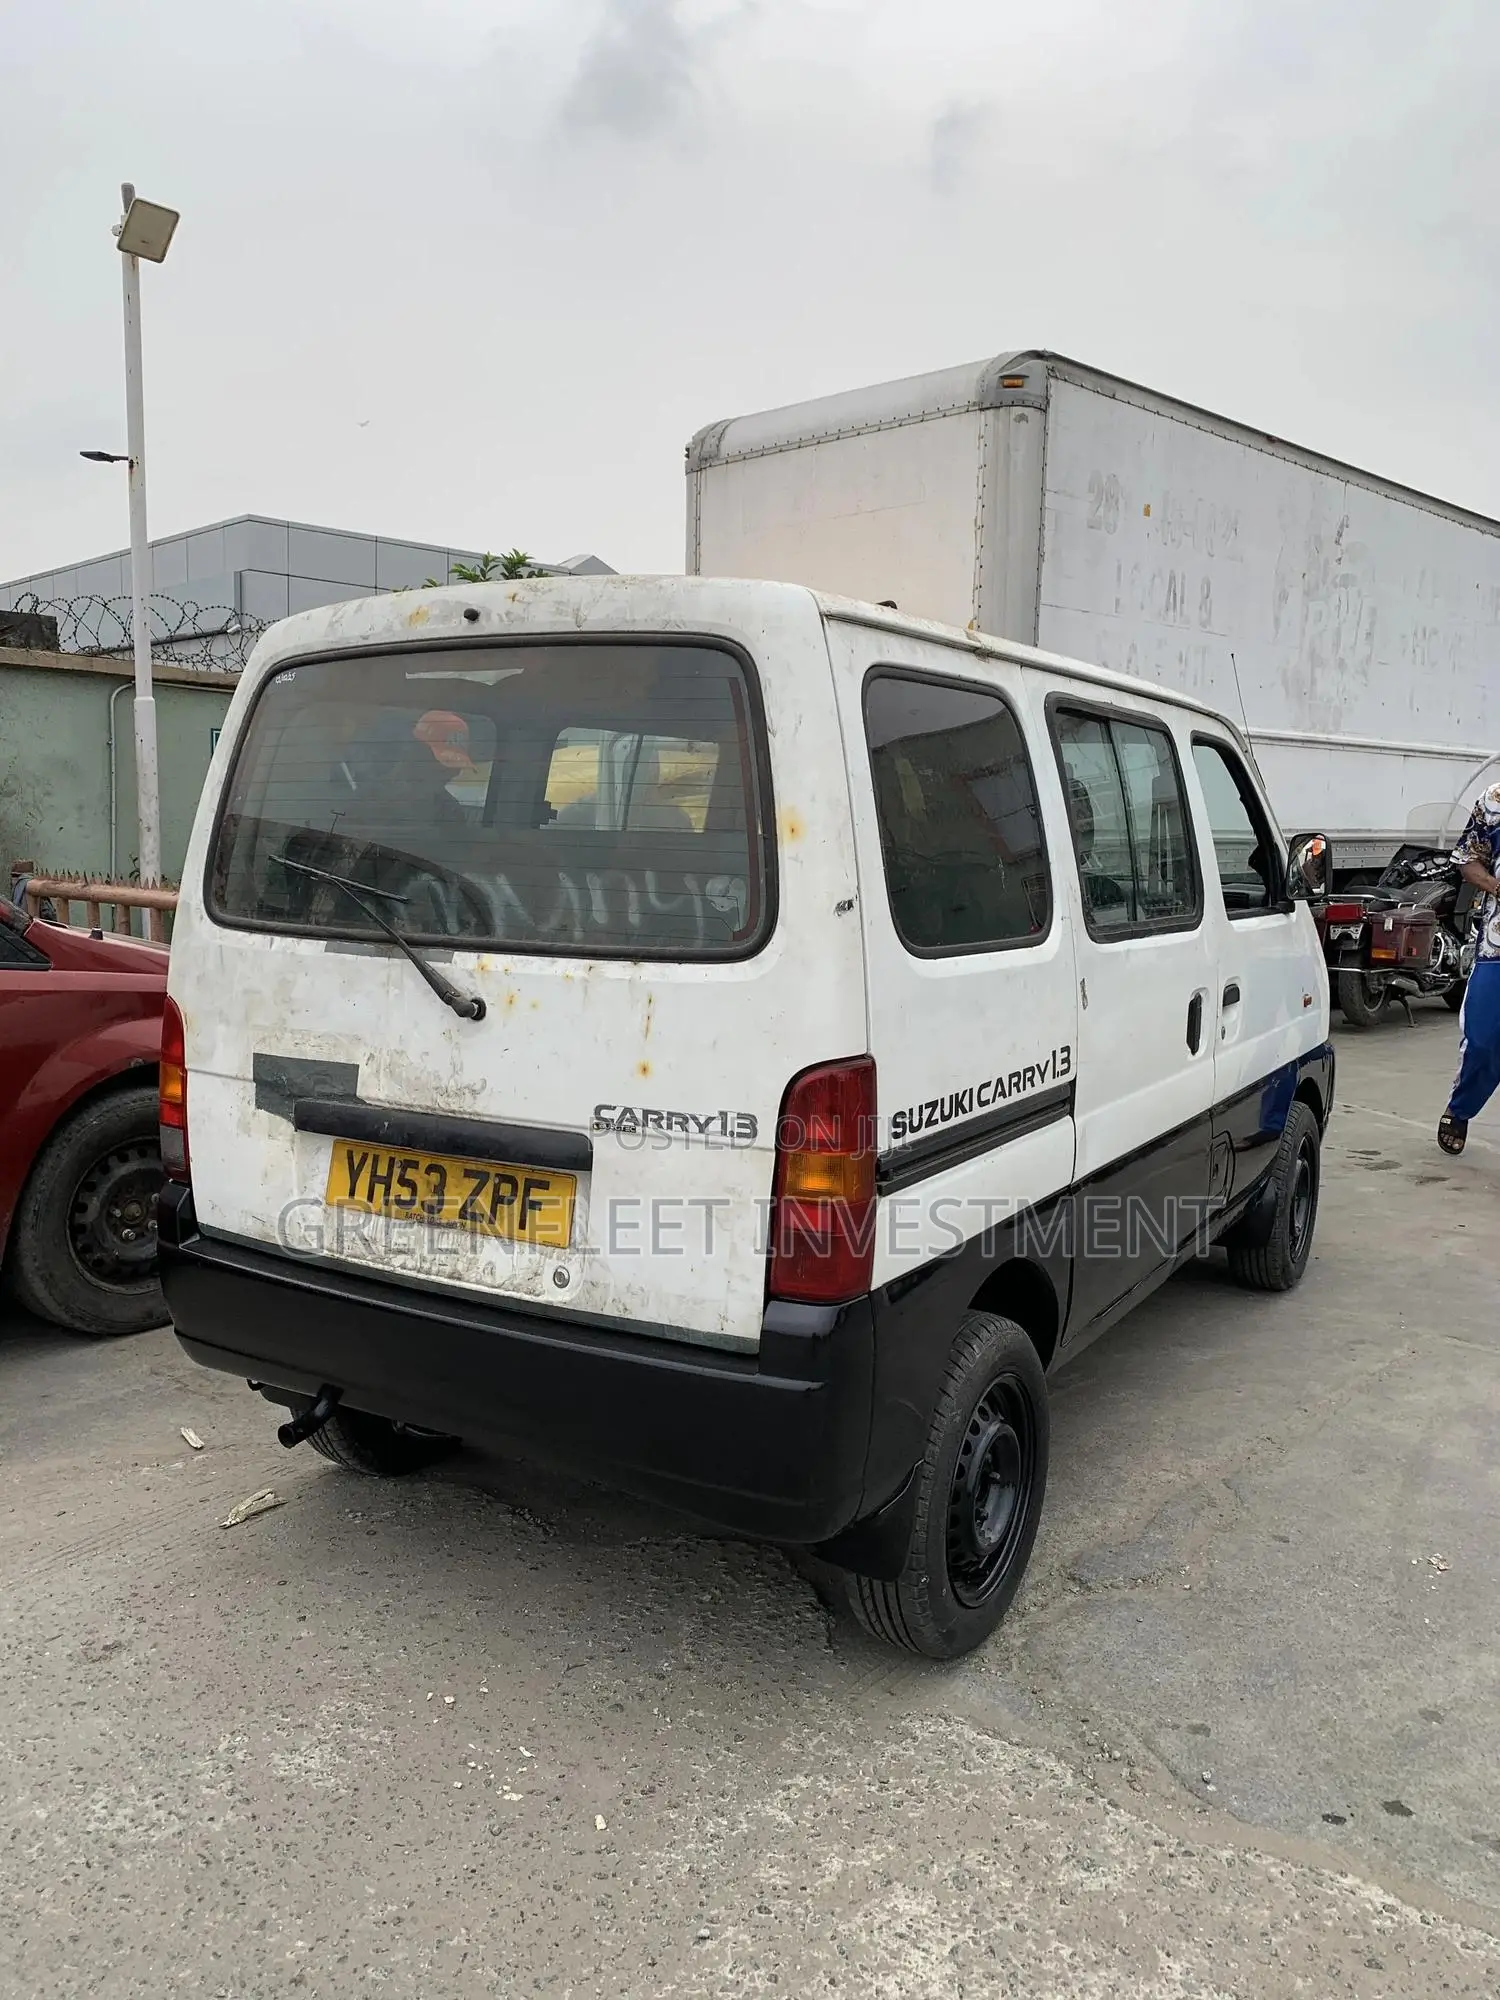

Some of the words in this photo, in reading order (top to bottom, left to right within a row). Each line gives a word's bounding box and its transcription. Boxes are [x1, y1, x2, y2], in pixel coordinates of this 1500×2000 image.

[594, 1104, 717, 1134] CARRY
[891, 1087, 974, 1139] SUZUKI
[977, 1059, 1050, 1108] CARRY
[1051, 1045, 1071, 1080] 1.3
[346, 1149, 448, 1215] YH53
[458, 1168, 551, 1231] ZPF
